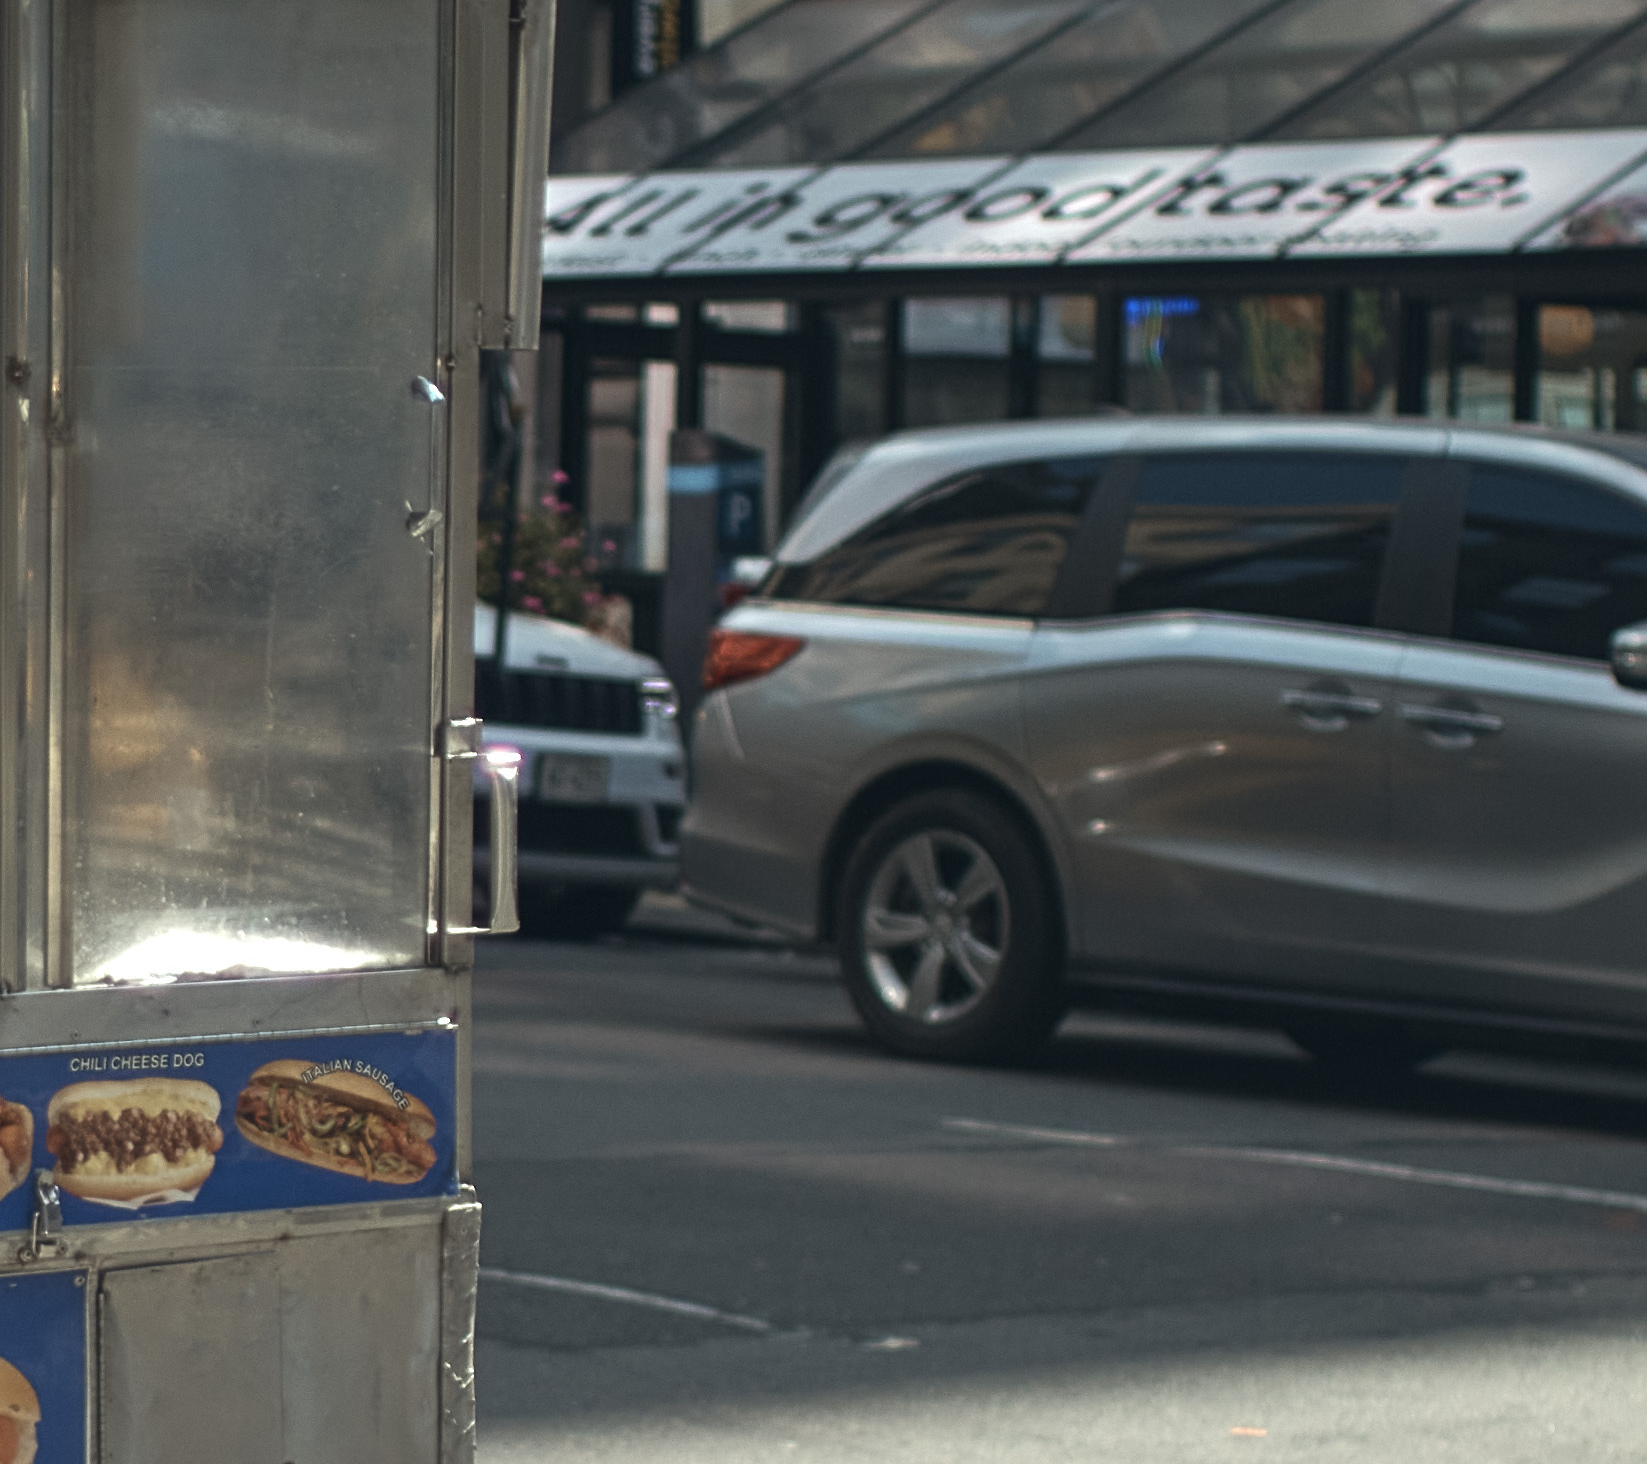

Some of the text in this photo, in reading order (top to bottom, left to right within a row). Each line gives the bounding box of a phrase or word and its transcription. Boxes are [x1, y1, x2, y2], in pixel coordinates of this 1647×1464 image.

[786, 165, 1167, 243] good
[70, 1053, 205, 1072] CHILI CHEESE DOG
[301, 1059, 411, 1111] ITALIAN SAUSAGE
